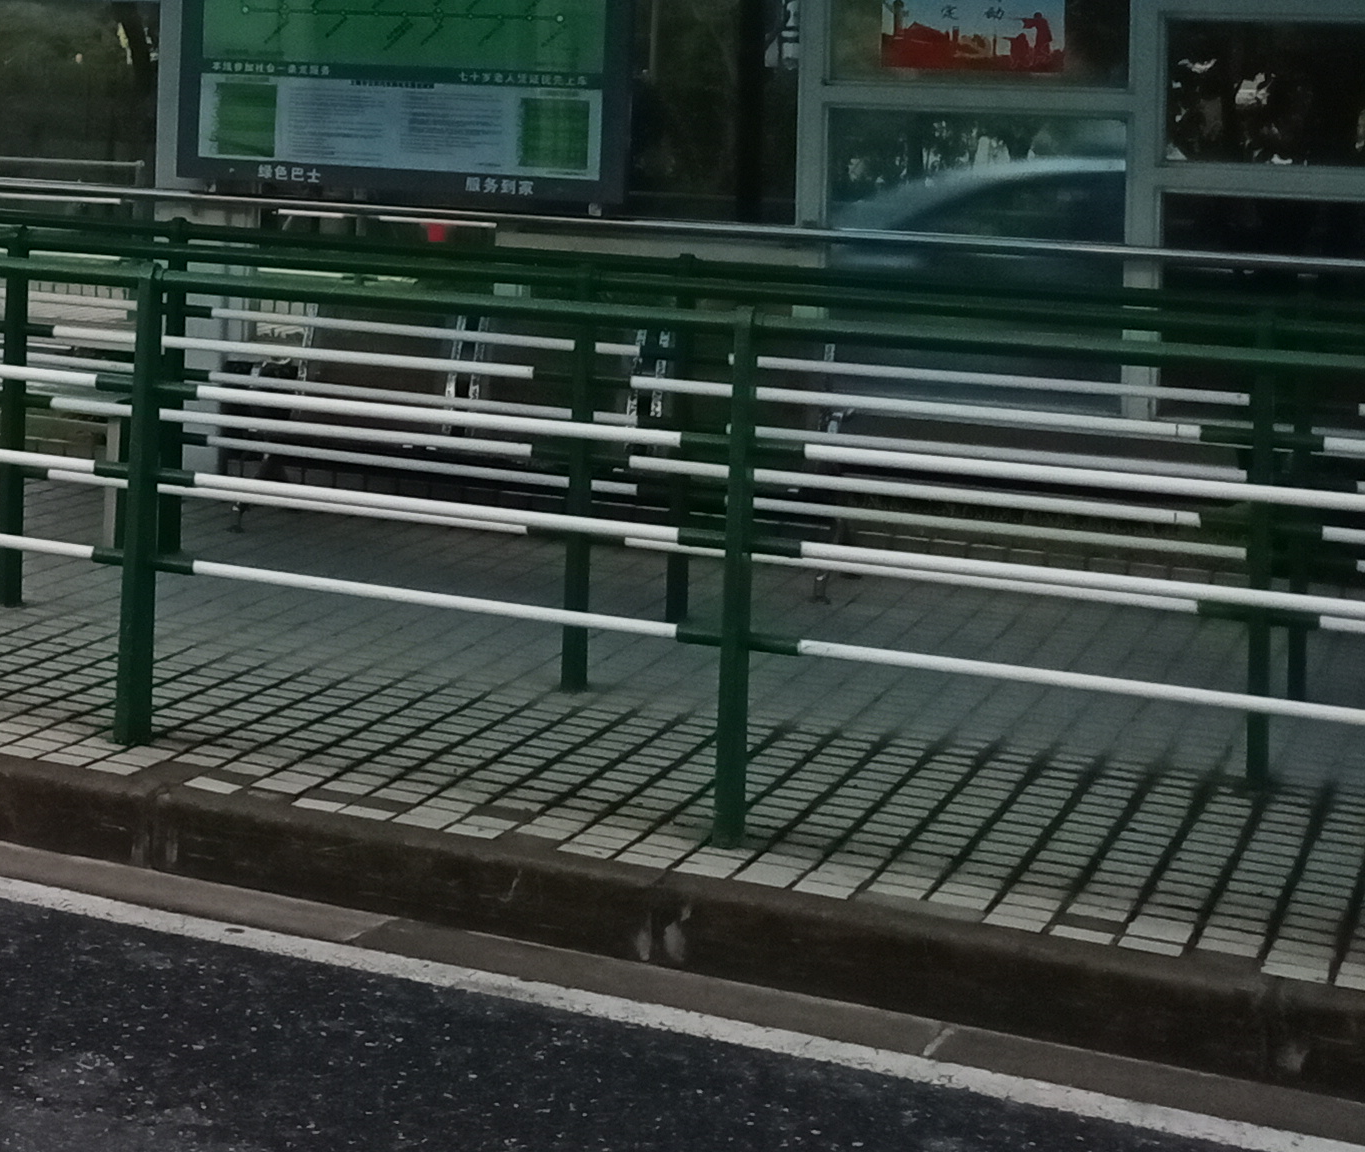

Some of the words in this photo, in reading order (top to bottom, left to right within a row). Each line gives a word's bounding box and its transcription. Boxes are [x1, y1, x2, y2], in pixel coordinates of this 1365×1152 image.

[257, 163, 322, 184] 绿色巴士
[465, 175, 534, 196] 服务到家
